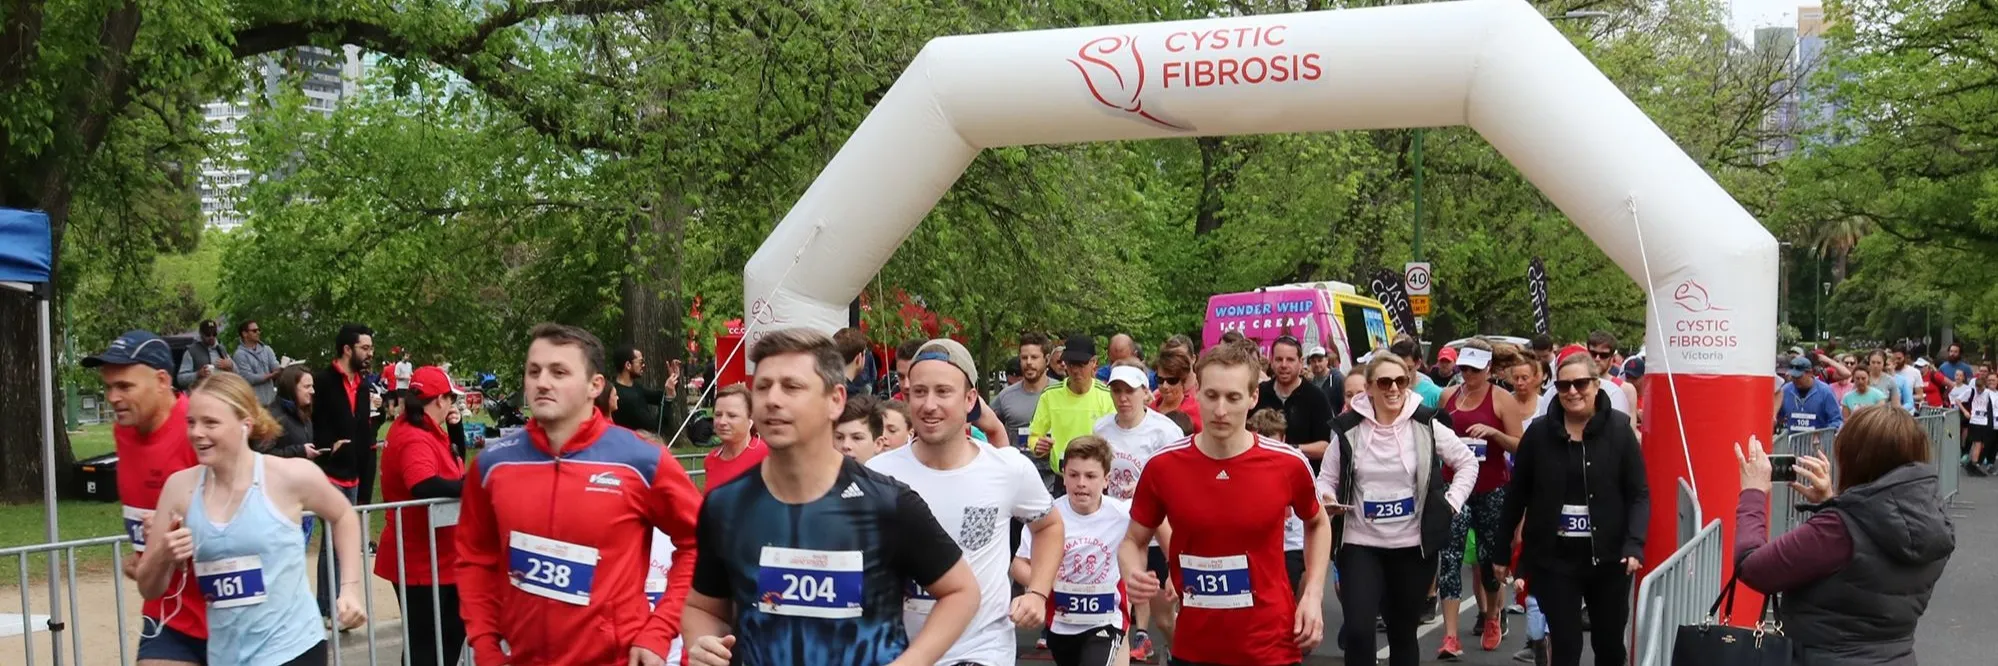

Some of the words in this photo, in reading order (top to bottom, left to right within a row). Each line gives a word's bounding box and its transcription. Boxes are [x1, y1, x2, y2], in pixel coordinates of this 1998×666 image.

[1164, 25, 1288, 53] CYSTIC
[1162, 53, 1322, 89] FIBROSIS
[1409, 273, 1427, 285] 40
[1385, 281, 1409, 312] JAG
[1527, 266, 1547, 335] COFFE
[1215, 303, 1272, 317] WONDER
[1277, 300, 1314, 313] WHIP
[1220, 320, 1246, 332] ICE
[1252, 317, 1309, 329] CREAM
[1676, 319, 1730, 332] CYSTIC
[1669, 335, 1738, 348] FIBROSIS
[1681, 350, 1724, 361] Victoria
[1376, 502, 1403, 517] 236
[524, 557, 572, 588] 238
[213, 575, 244, 597] 161
[781, 573, 837, 603] 204
[1196, 574, 1229, 593] 131
[1068, 597, 1100, 612] 316
